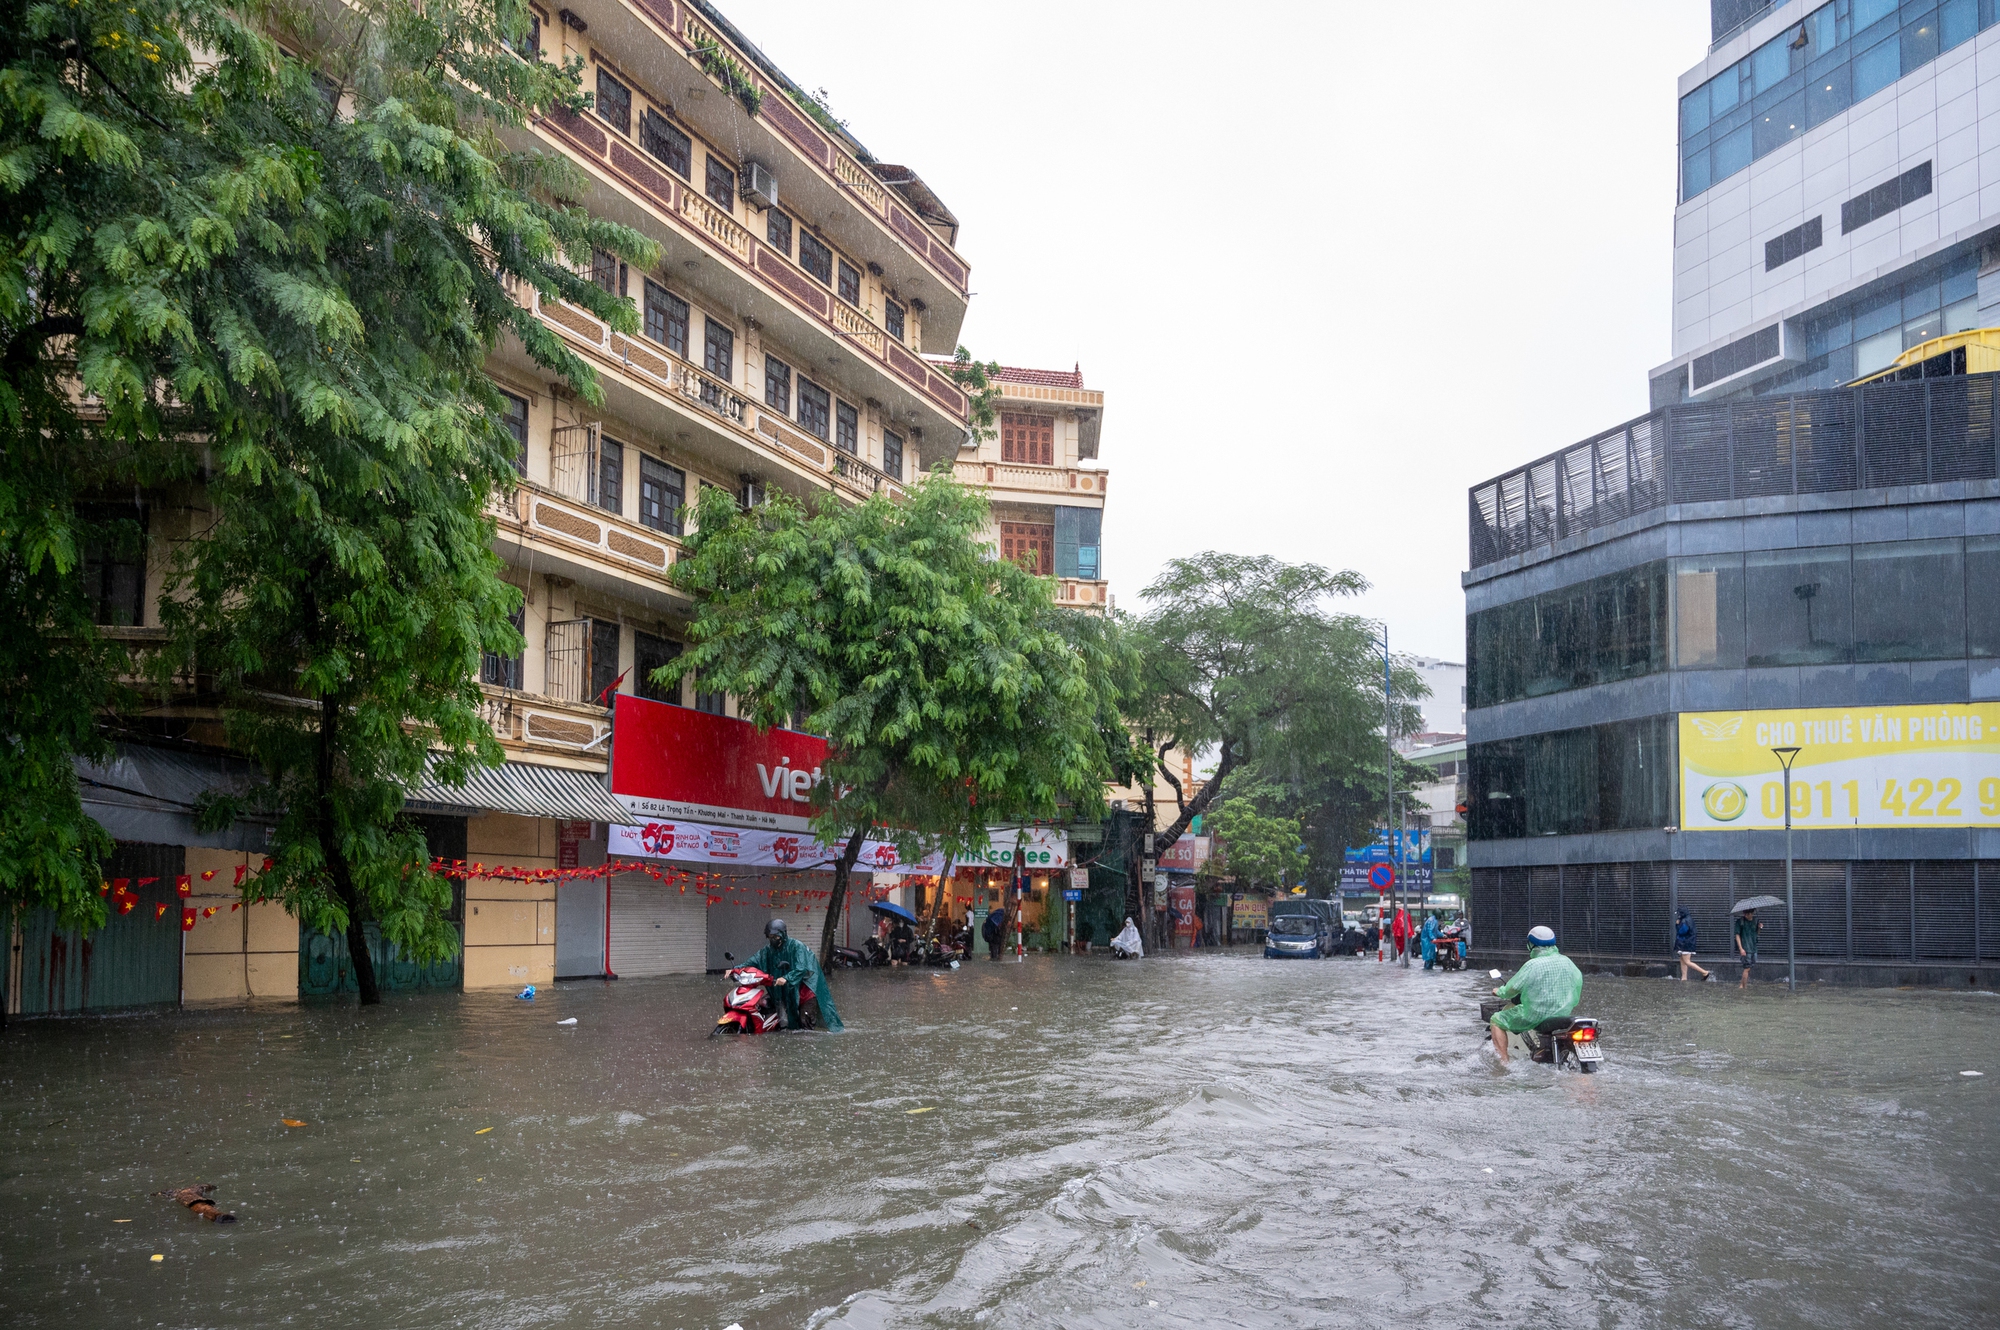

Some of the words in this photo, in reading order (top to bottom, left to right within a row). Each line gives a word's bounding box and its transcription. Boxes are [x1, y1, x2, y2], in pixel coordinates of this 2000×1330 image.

[1756, 722, 1795, 746] CHO
[1802, 715, 1852, 745] THUÊ
[1859, 713, 1901, 743] VĂN
[1908, 710, 1982, 741] PHÒNG
[642, 801, 650, 810] Số
[658, 804, 665, 812] Lê
[667, 805, 682, 815] Trọng
[731, 813, 744, 821] Thanh
[1761, 780, 1859, 819] 0911
[1880, 777, 1962, 817] 422
[1978, 776, 2000, 817] 9
[641, 823, 675, 855] 5G
[773, 837, 799, 865] 5G
[990, 845, 1050, 863] coee
